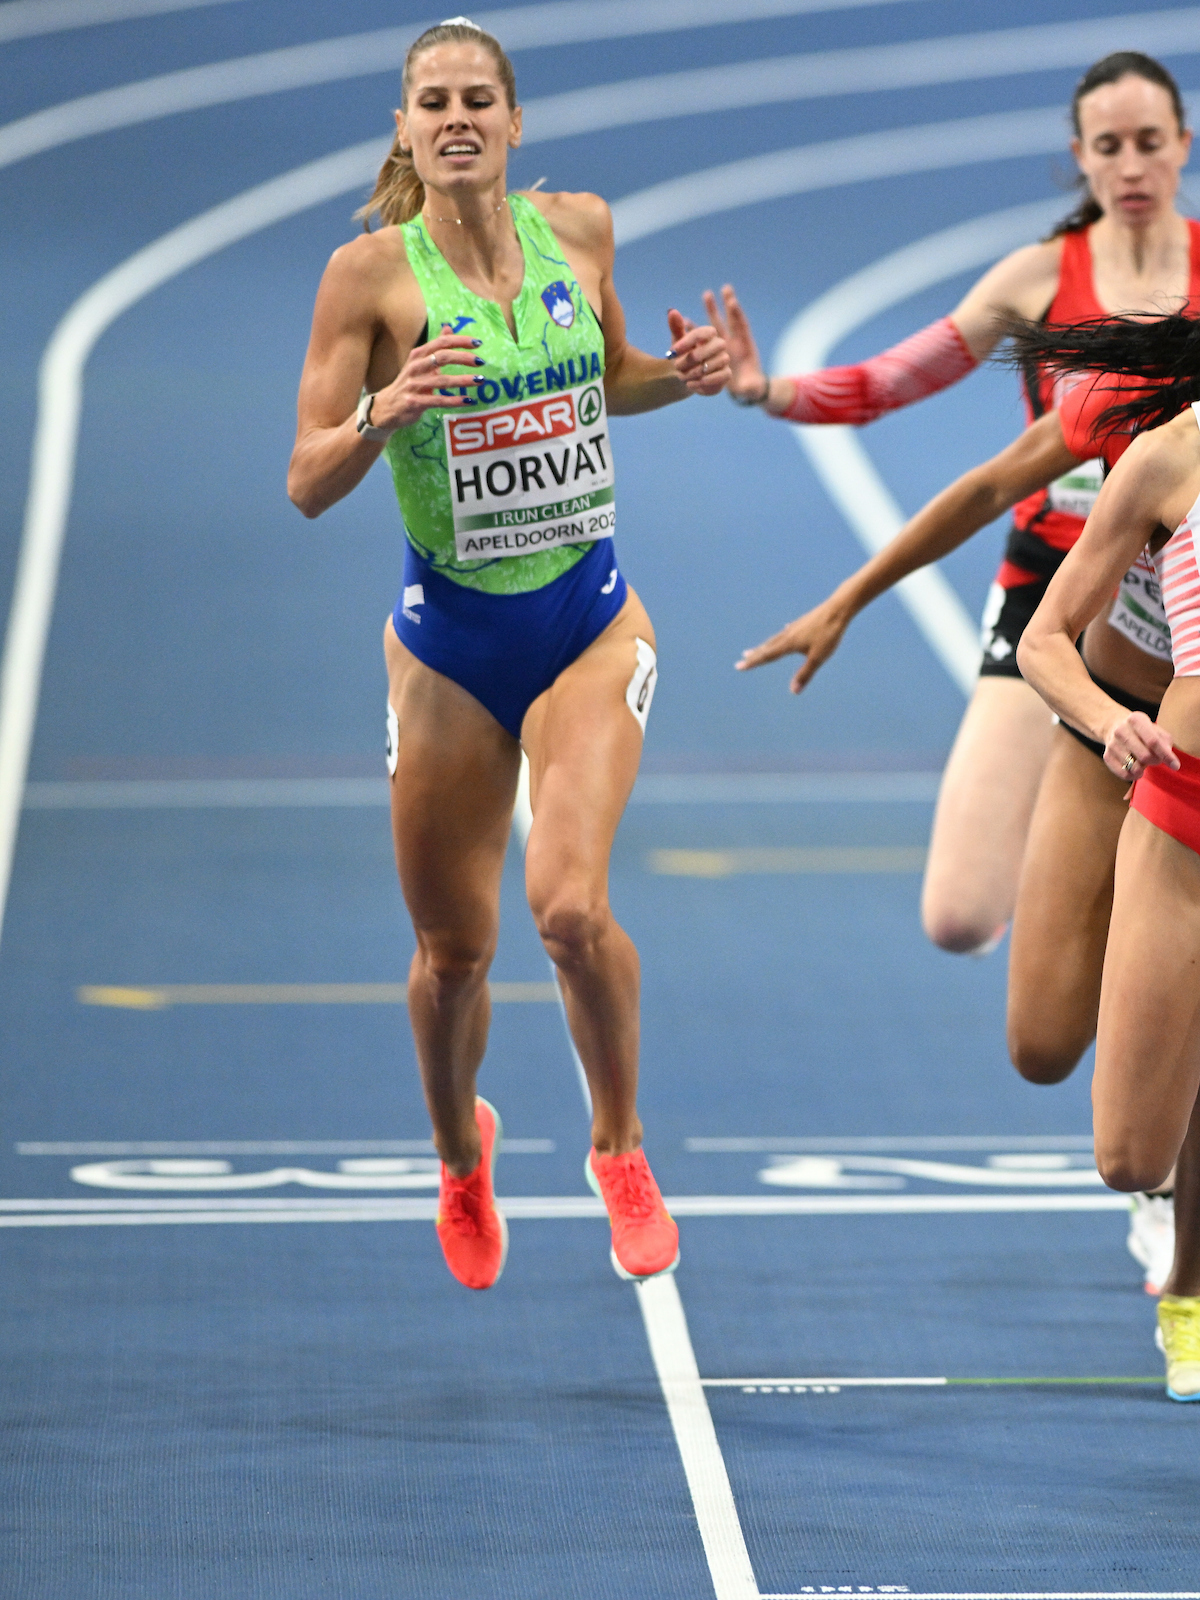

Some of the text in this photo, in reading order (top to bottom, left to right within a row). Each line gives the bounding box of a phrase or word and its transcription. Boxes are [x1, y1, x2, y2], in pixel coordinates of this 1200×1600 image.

[439, 352, 601, 406] OVENIJA
[453, 400, 575, 451] SPAR
[454, 433, 608, 503] HORVAT
[465, 511, 615, 552] APELDOORN 202
[494, 513, 499, 526] I
[502, 506, 540, 525] RUN
